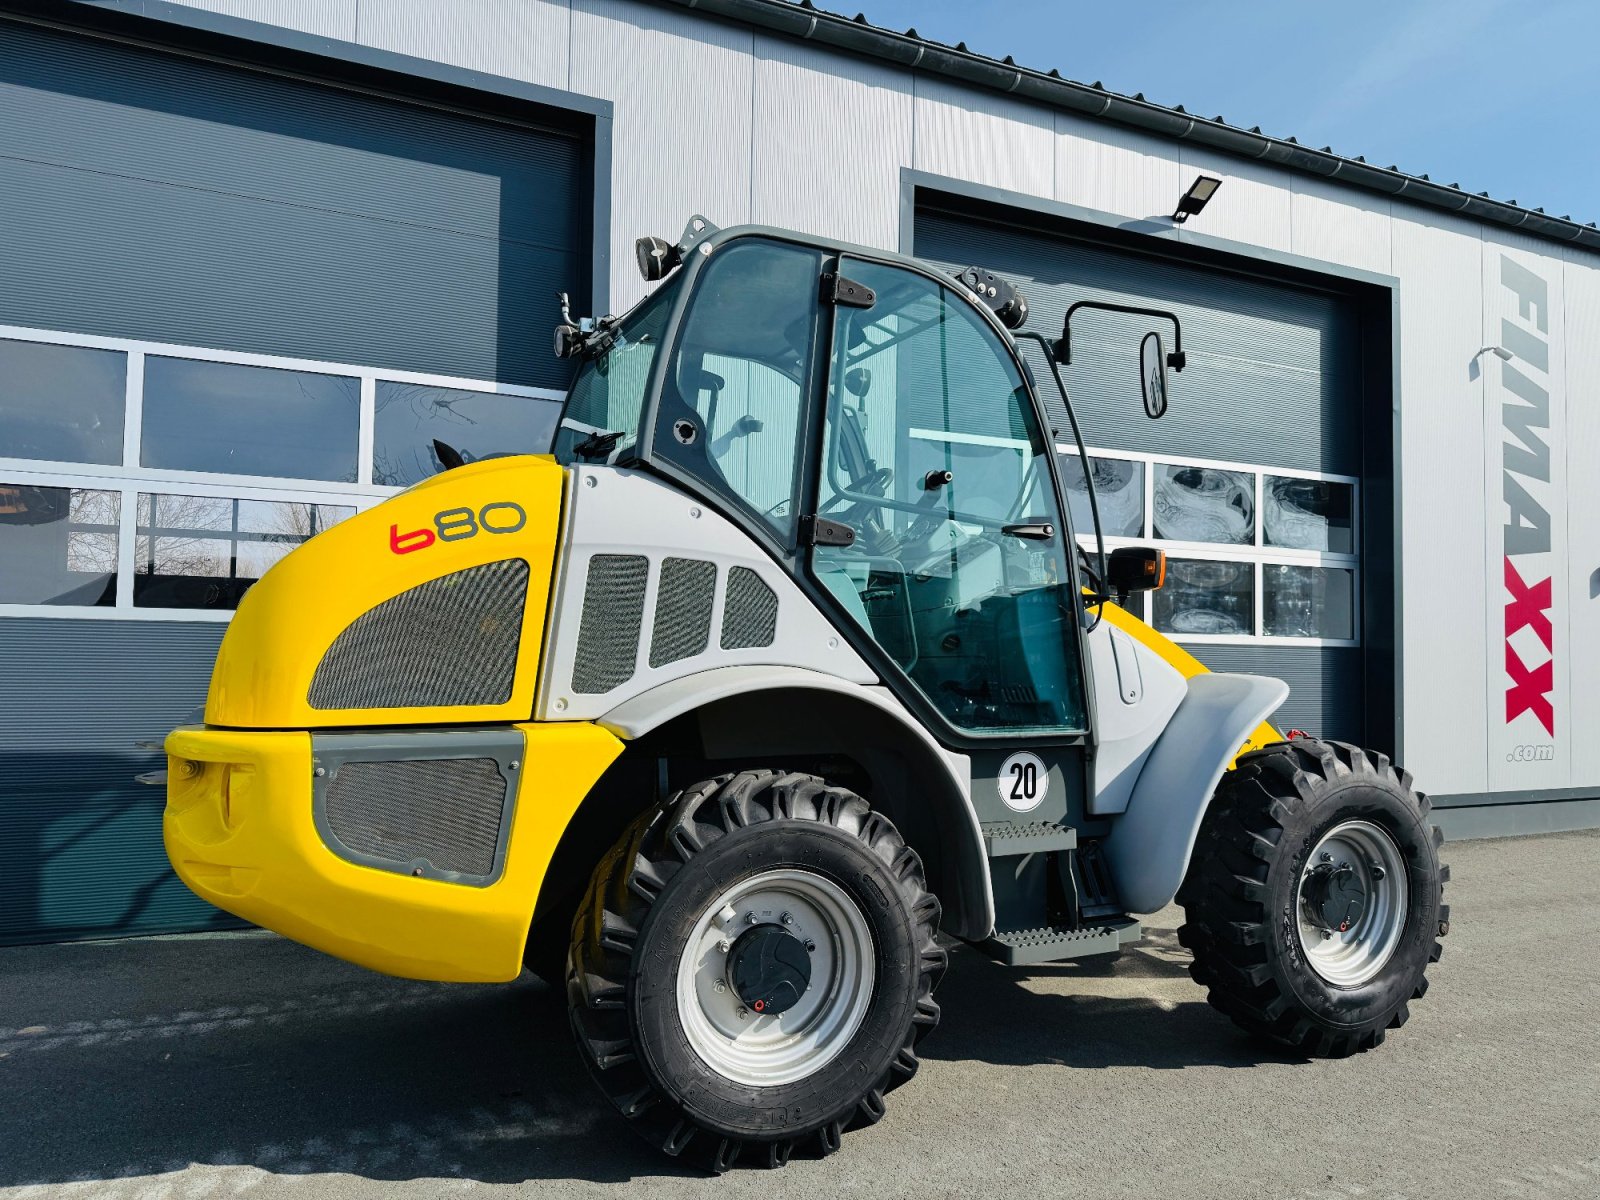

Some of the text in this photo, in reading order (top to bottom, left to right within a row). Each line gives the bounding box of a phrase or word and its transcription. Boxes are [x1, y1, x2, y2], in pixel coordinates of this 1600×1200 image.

[1500, 253, 1554, 739] FIMAXX
[1506, 744, 1554, 762] .com
[1010, 762, 1037, 800] 20
